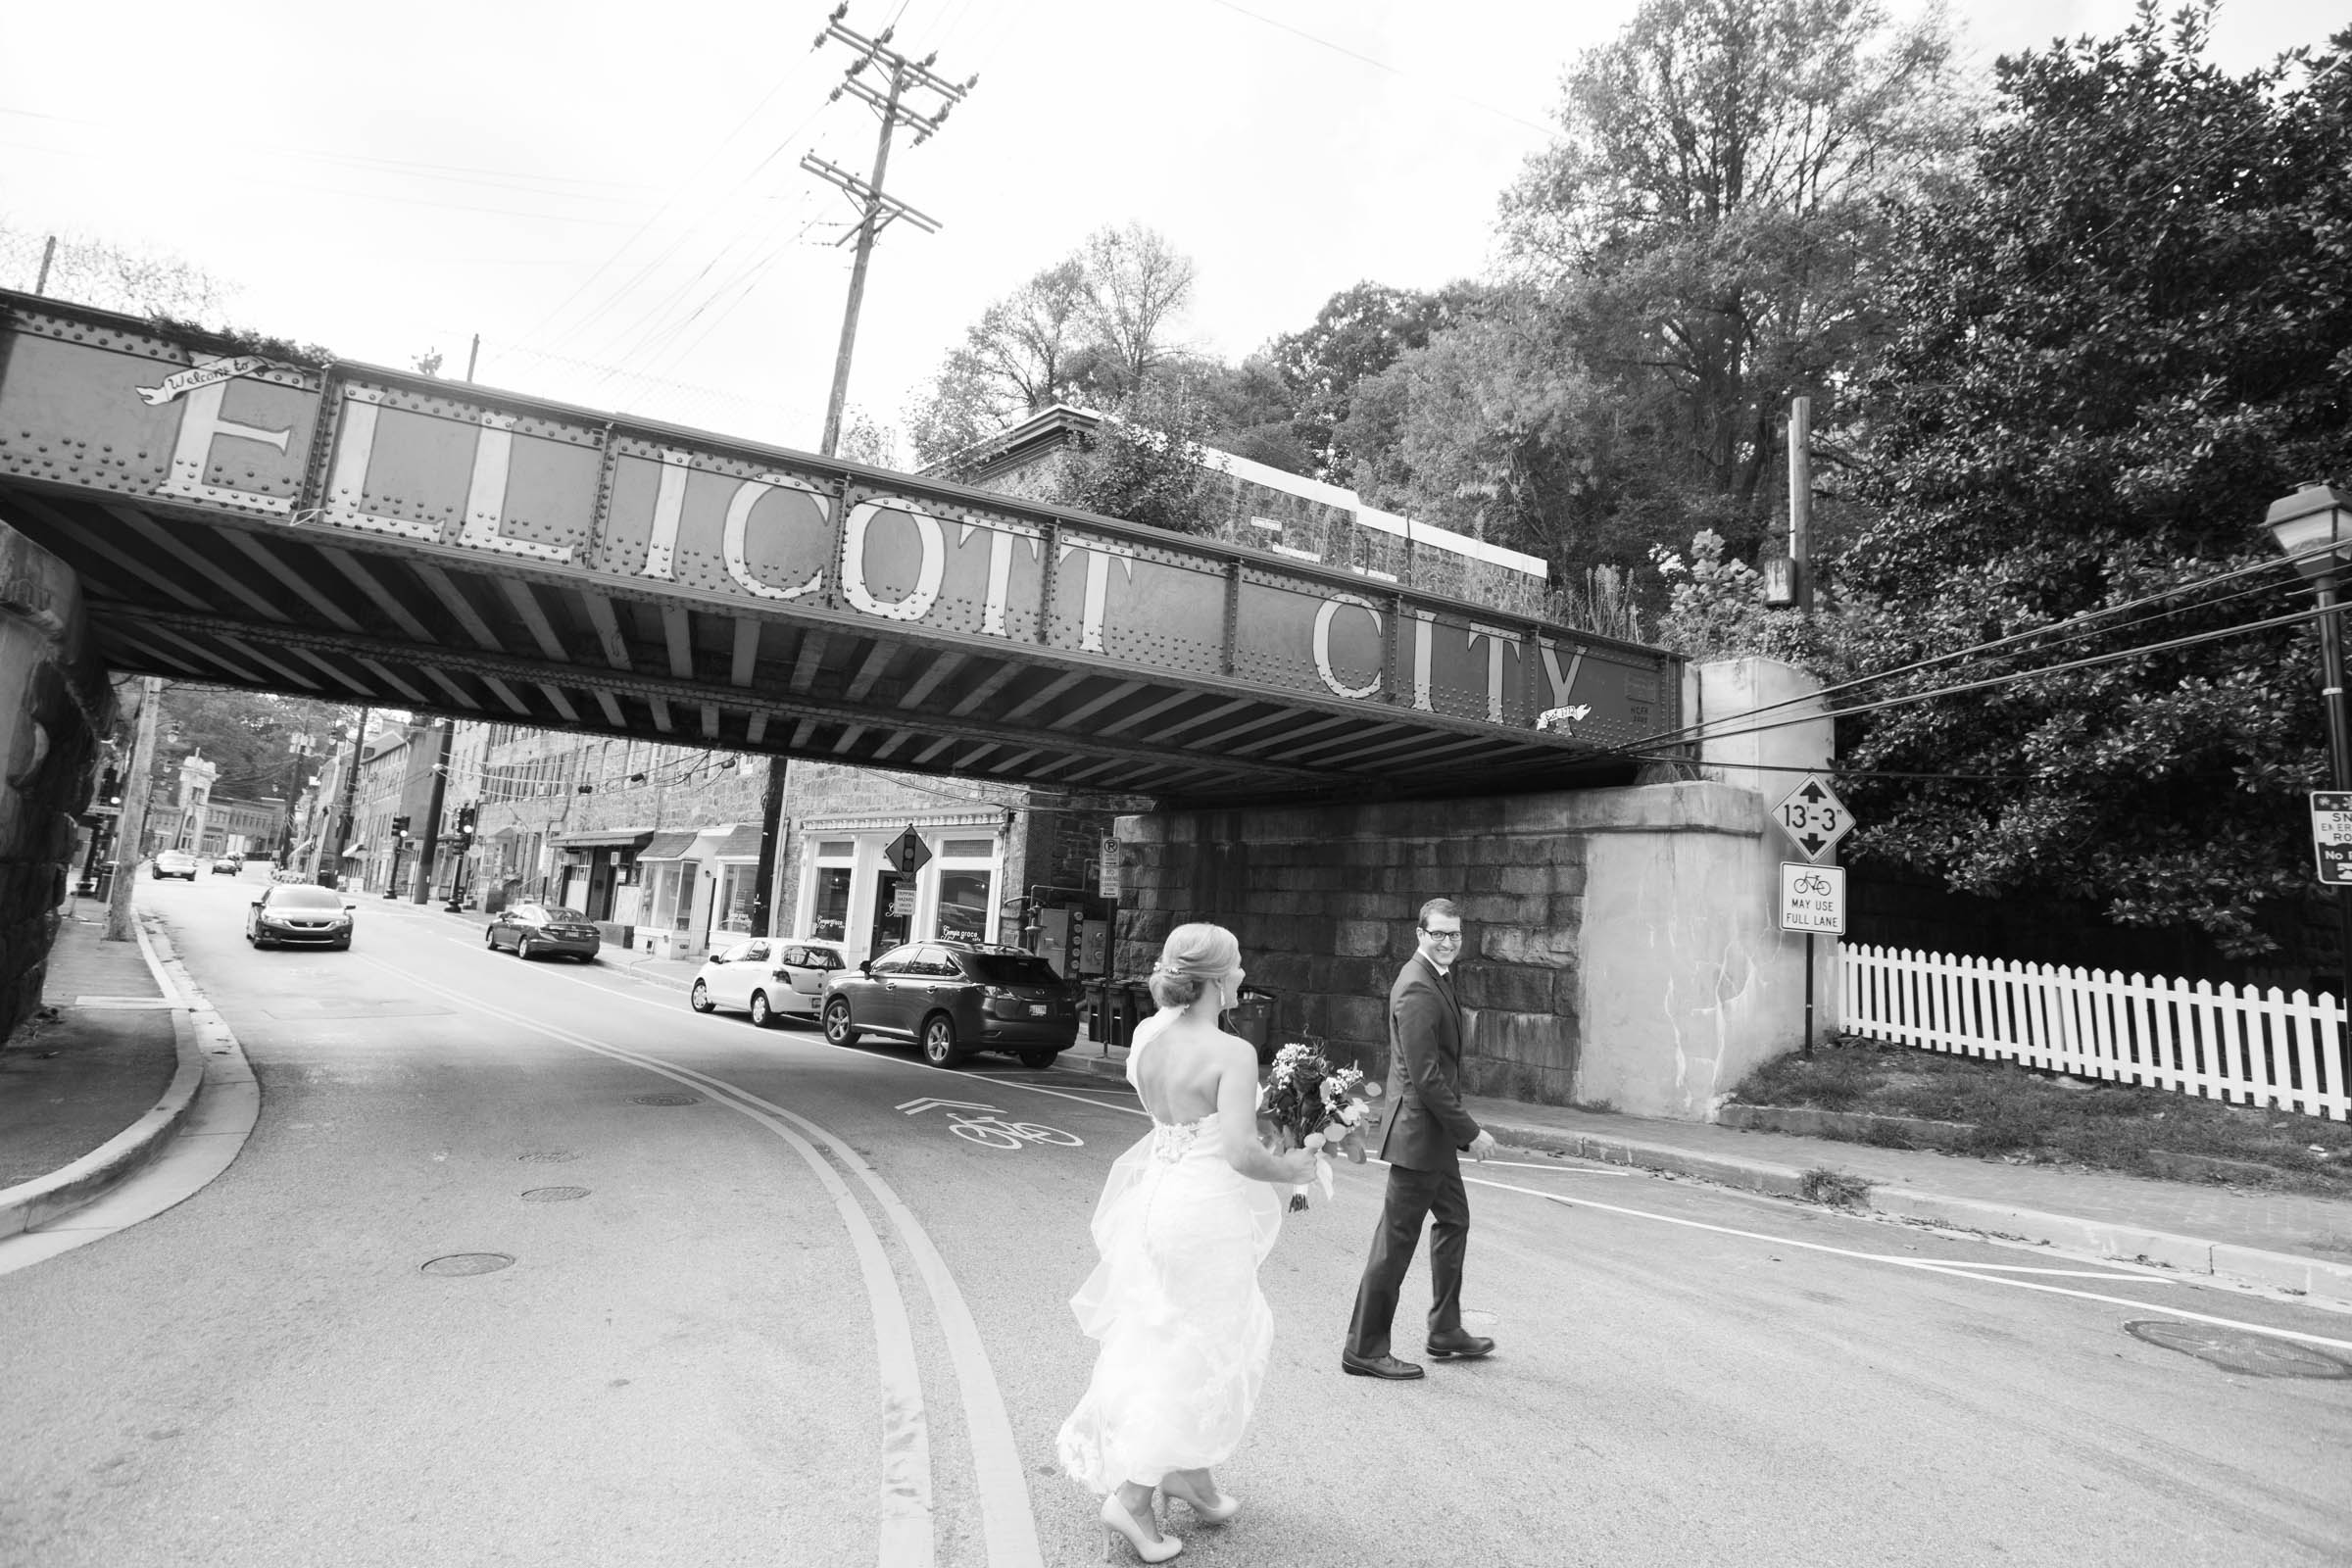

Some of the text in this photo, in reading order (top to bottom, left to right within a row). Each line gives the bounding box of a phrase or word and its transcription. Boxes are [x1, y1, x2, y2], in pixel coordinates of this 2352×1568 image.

[233, 359, 249, 372] to
[156, 350, 1587, 737] ELLICOTT CITY
[2325, 850, 2343, 860] No
[1791, 899, 1834, 911] MAY USE
[1787, 912, 1838, 928] FULL LANE
